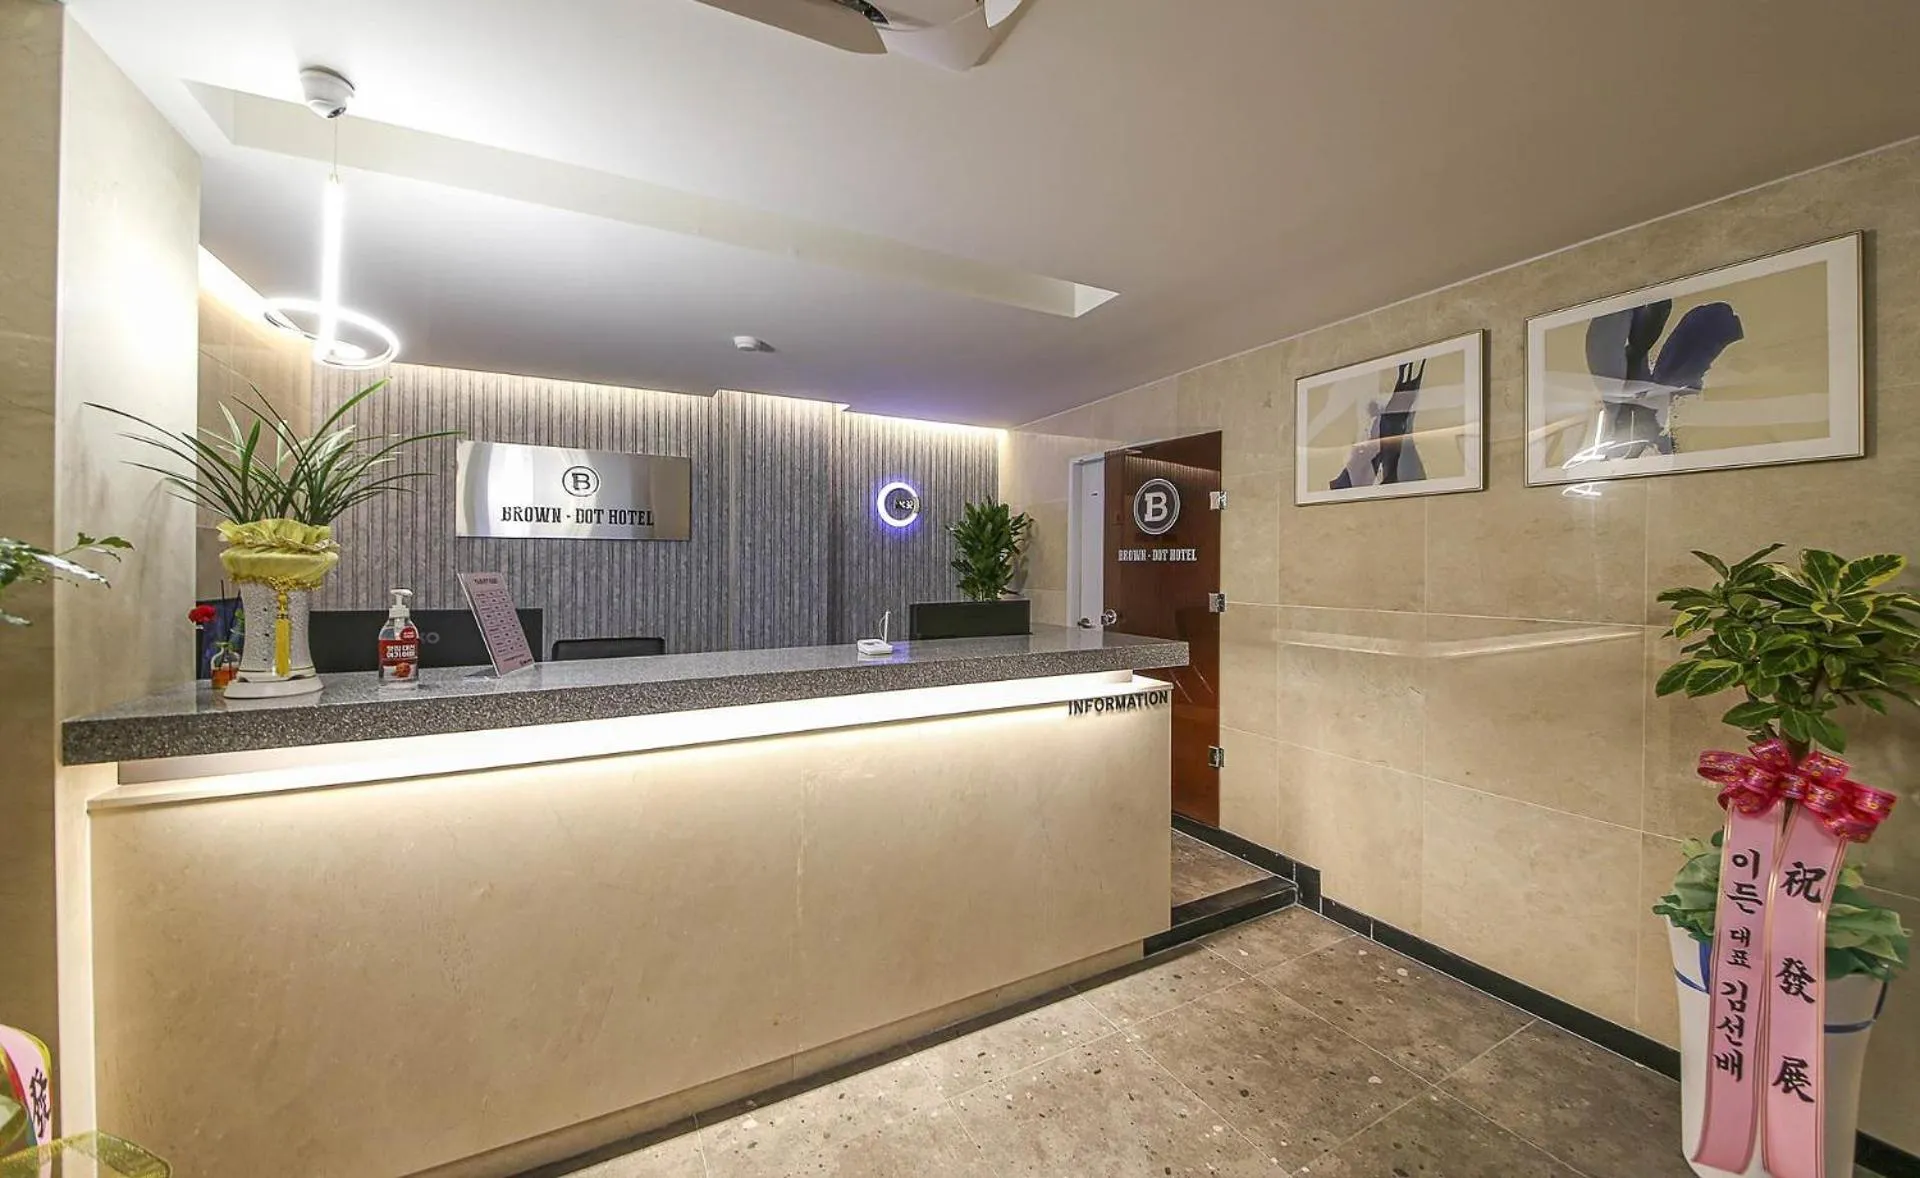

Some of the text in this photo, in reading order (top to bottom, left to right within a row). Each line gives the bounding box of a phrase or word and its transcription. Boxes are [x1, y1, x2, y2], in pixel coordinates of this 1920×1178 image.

[501, 507, 561, 523] BROWN
[576, 509, 604, 525] DOT
[608, 510, 654, 526] HOTEL
[1169, 549, 1197, 561] HOTEL
[1068, 690, 1168, 715] INFORMATION
[1715, 849, 1763, 1083] 이든 대표 김선배
